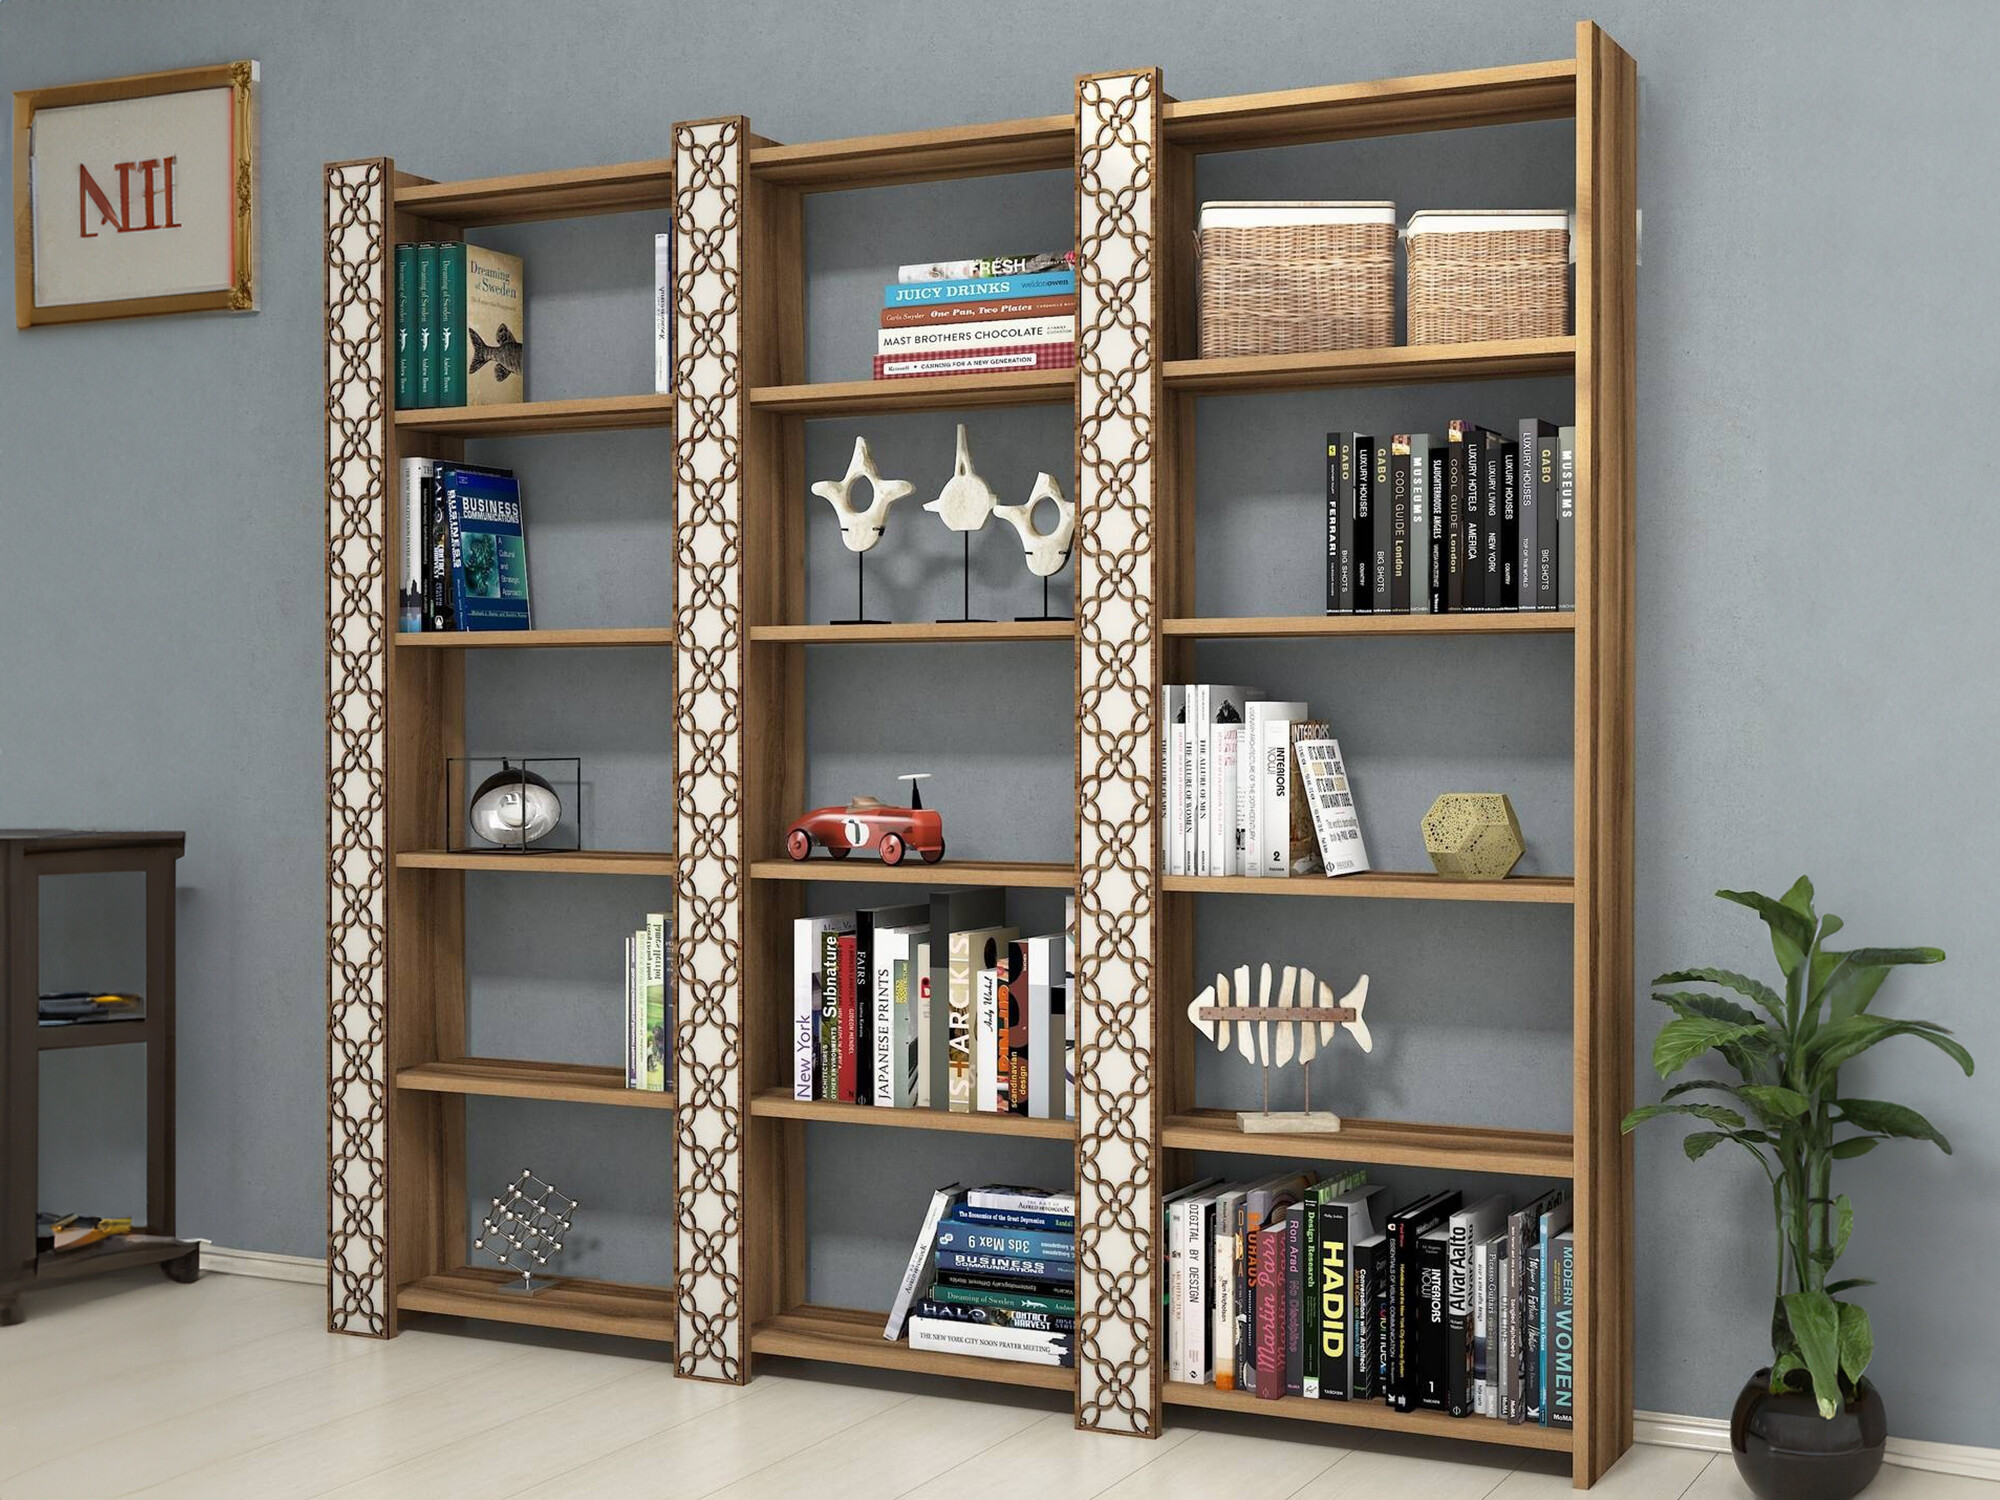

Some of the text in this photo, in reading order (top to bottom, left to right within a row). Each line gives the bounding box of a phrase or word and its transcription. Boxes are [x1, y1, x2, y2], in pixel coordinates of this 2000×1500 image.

[420, 261, 428, 290] Dreaming
[441, 260, 450, 290] Dreaming
[470, 260, 510, 284] Dreaming
[970, 259, 1026, 276] FRESH
[482, 277, 516, 299] Sweden
[896, 282, 1010, 301] JUICY DRINKS
[931, 304, 1032, 318] One Pan, Two Plates
[884, 327, 1043, 346] MAST BROTHERS CHOCOLATE
[1377, 448, 1386, 483] GABO
[1450, 459, 1458, 490] COOL
[1468, 444, 1477, 512] LUXURY HOTELS
[1523, 432, 1531, 506] LUXURY HOUSES
[1542, 449, 1551, 483] GABO
[435, 467, 443, 523] HALO
[1413, 457, 1422, 523] MUSEUMS
[1433, 460, 1442, 539] SLAUGHTERHOUSE ANGELS
[1488, 460, 1496, 516] LUXURY LIVING
[1505, 455, 1513, 520] LUXURY HOUSES
[1562, 451, 1572, 518] MUSEUMS
[462, 497, 519, 515] BUSINESS
[463, 510, 519, 524] COMMUNICATIONS
[1450, 494, 1458, 529] GUIDE
[1394, 470, 1405, 577] COOL GUIDE London
[1468, 522, 1477, 559] AMERICA
[1267, 747, 1276, 775] NOW!
[1276, 747, 1285, 797] INTERIORS
[1186, 790, 1192, 802] OF
[1200, 789, 1206, 800] OF
[1274, 851, 1280, 861] 2
[822, 936, 837, 1018] Subnature
[857, 951, 866, 985] FAIRS
[878, 969, 891, 1100] JAPANESE PRINTS
[983, 1010, 993, 1032] Andy
[796, 1015, 811, 1098] New York
[1010, 1051, 1018, 1108] scandinavian
[1019, 1065, 1027, 1095] design
[1307, 1211, 1315, 1244] Design
[968, 1235, 1030, 1253] 3ds Max 9
[1189, 1204, 1199, 1303] DIGITAL BY DESIGN
[1247, 1212, 1260, 1288] BAUHAUS
[955, 1255, 1045, 1269] BUSINESS
[955, 1262, 1044, 1274] COMMUNICATIONS
[1563, 1246, 1572, 1305] MODERN
[1288, 1220, 1299, 1352] Ron Arad No Discipline
[1389, 1274, 1395, 1284] OF
[1421, 1268, 1431, 1298] NOW!
[923, 1303, 985, 1320] HALO
[947, 1292, 1015, 1305] Dreaming of Sweden
[1257, 1234, 1276, 1373] Martin Parr
[1322, 1241, 1344, 1358] HADID
[1431, 1269, 1441, 1323] INTERIORS
[1012, 1311, 1048, 1322] CONTACT
[1014, 1320, 1050, 1330] HARVEST
[999, 1341, 1022, 1350] PRAYER
[1023, 1344, 1050, 1353] MEETING
[1555, 1310, 1572, 1406] WOMEN
[1429, 1381, 1434, 1393] 1
